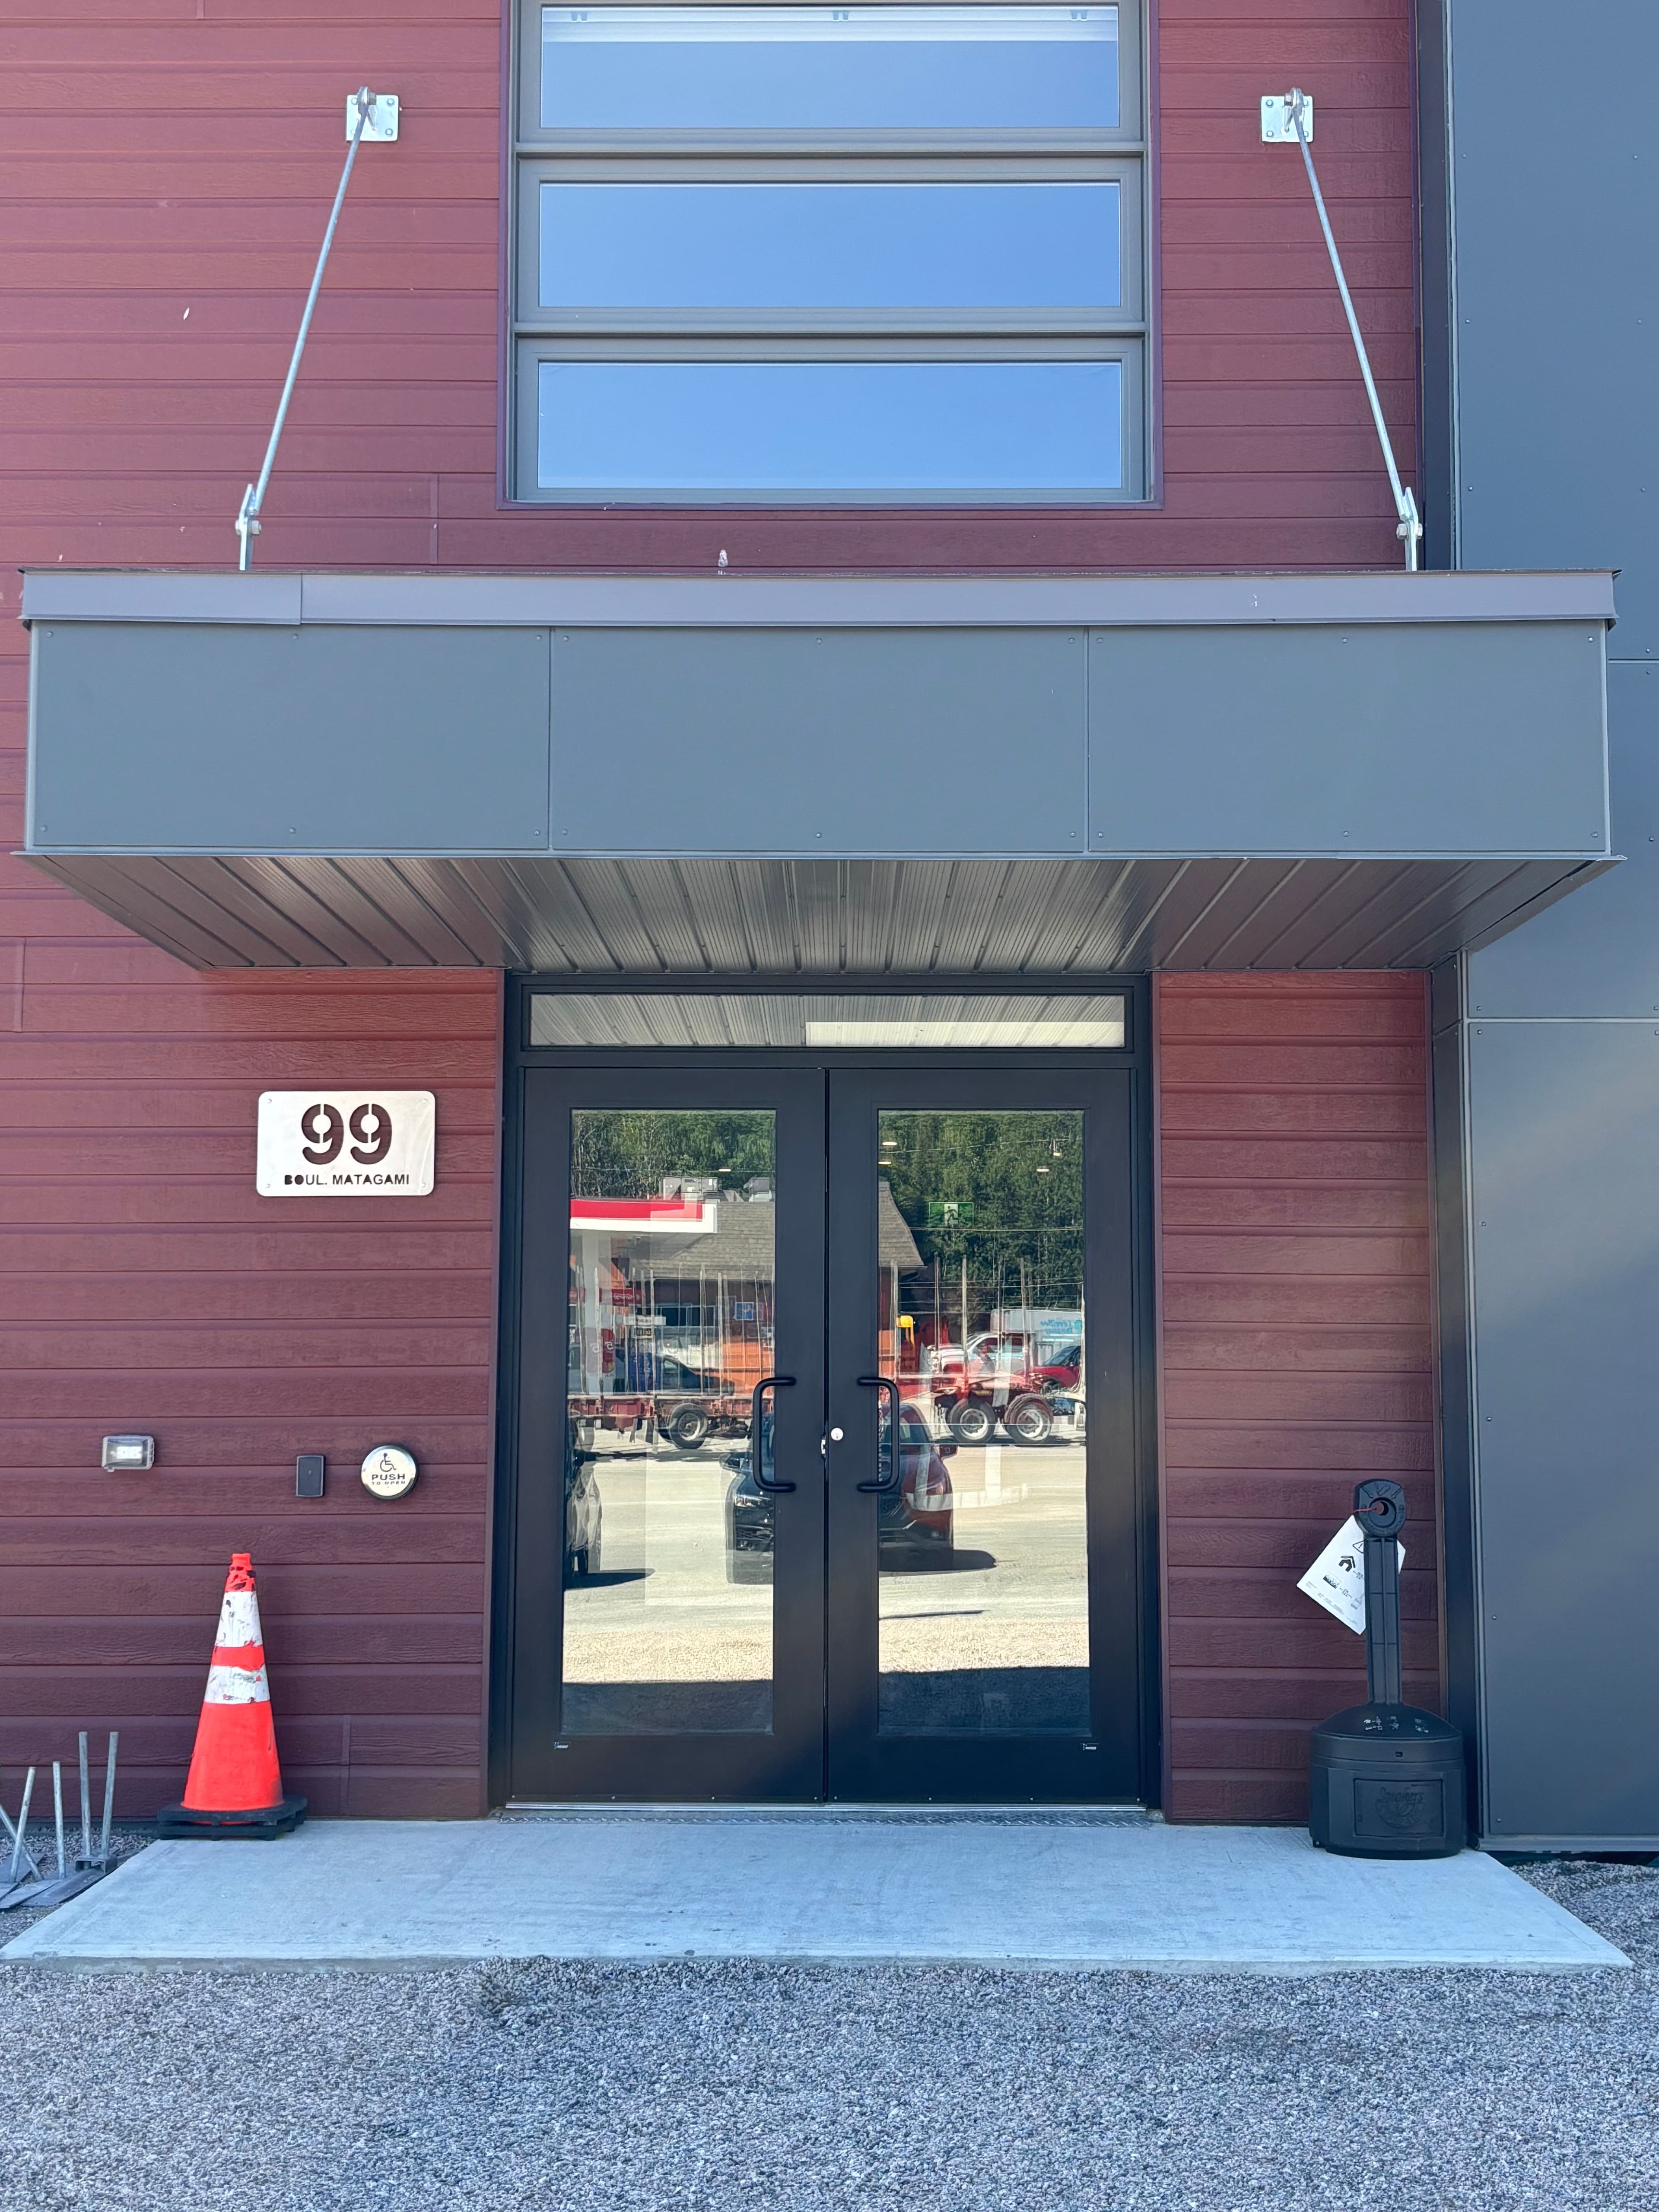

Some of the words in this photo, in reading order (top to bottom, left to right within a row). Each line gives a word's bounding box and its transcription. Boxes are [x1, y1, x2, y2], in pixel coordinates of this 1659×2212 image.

[301, 1103, 392, 1165] 99
[284, 1174, 327, 1185] BOUL.
[332, 1174, 410, 1185] MATAGAMI
